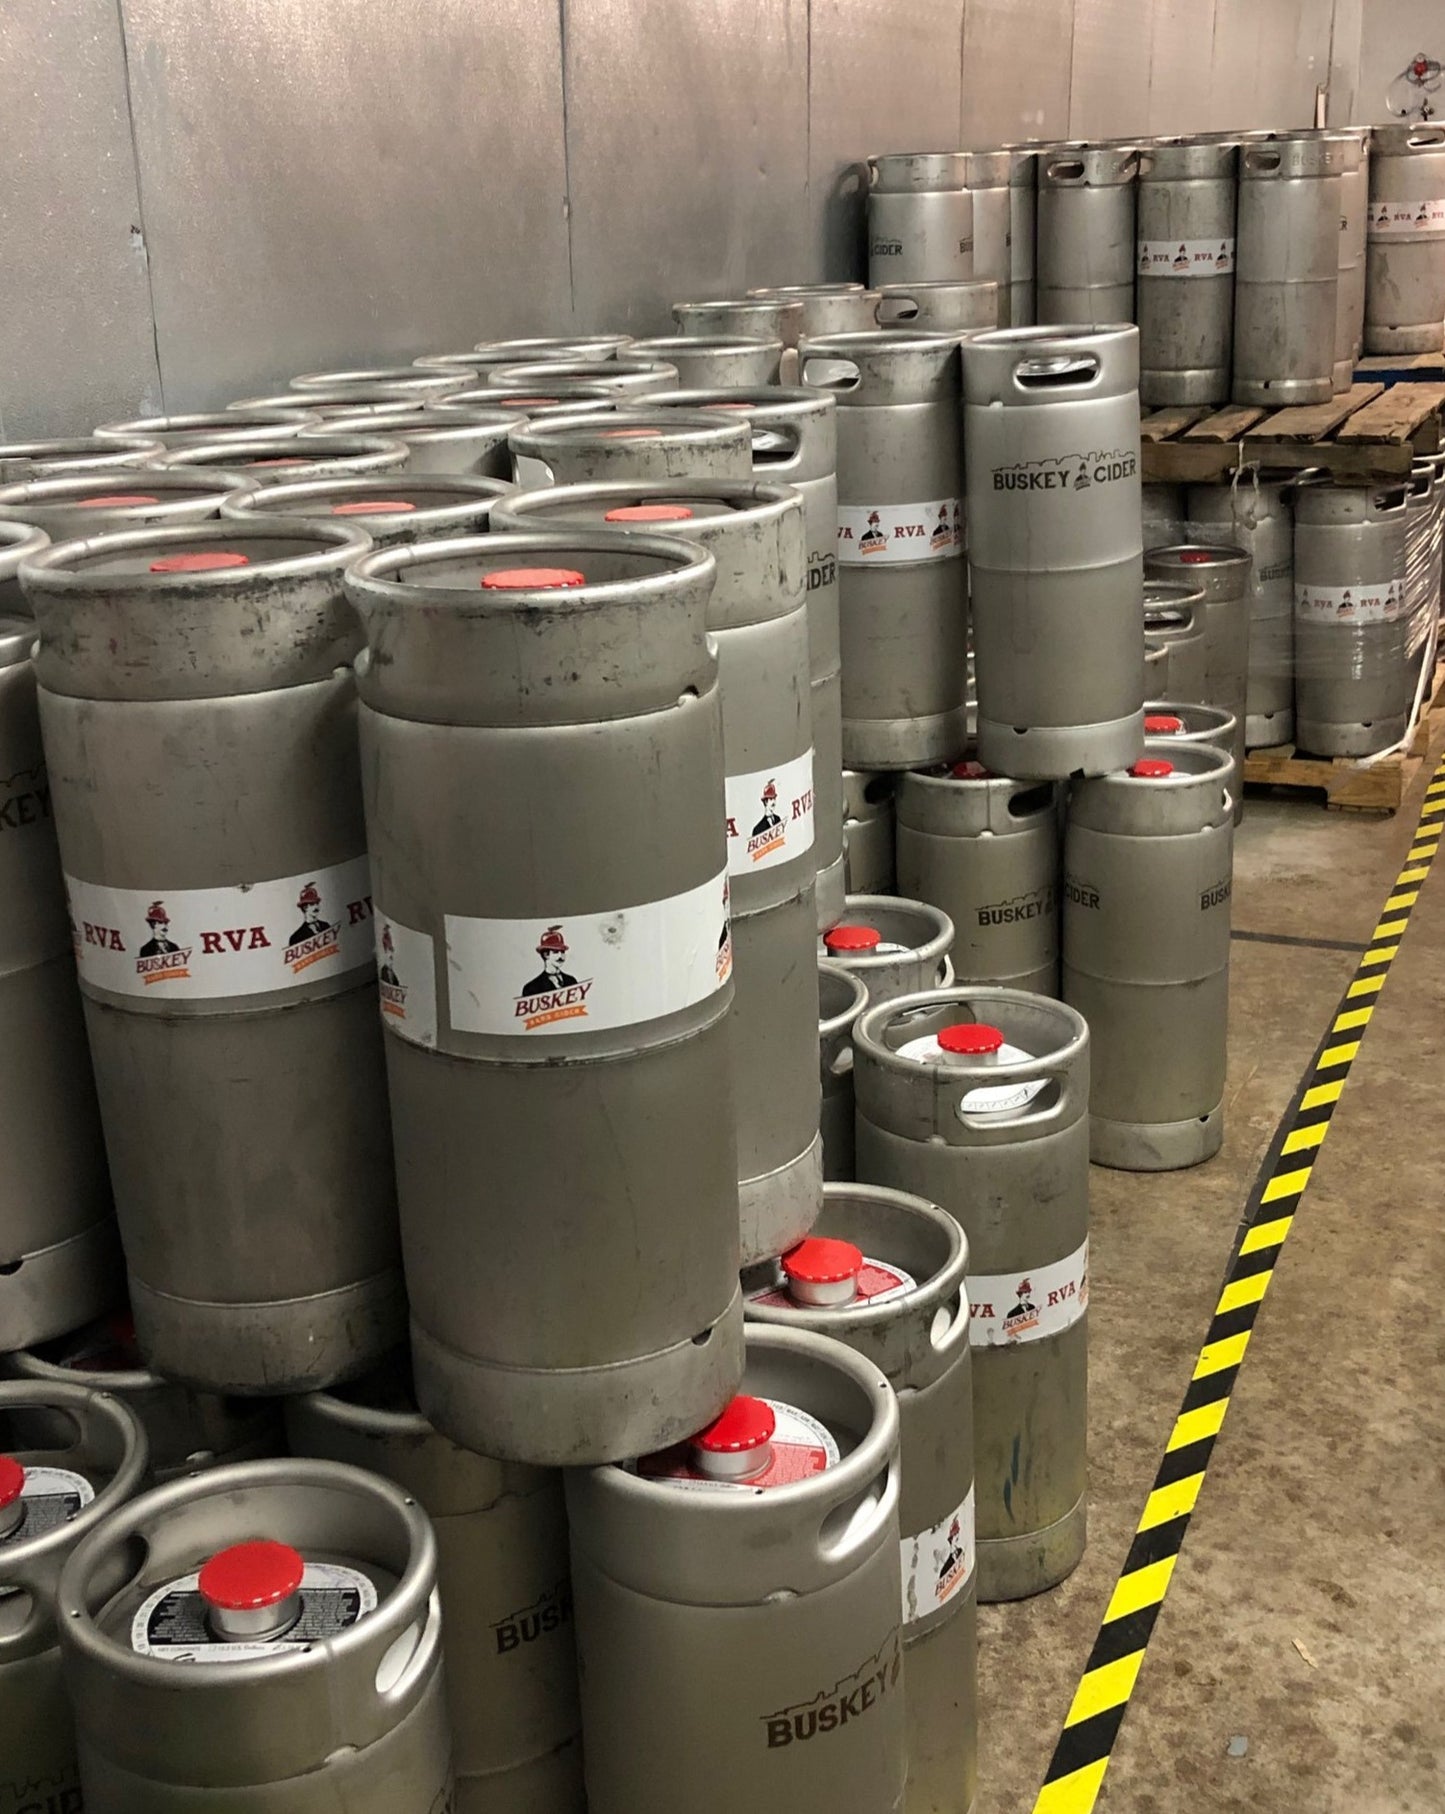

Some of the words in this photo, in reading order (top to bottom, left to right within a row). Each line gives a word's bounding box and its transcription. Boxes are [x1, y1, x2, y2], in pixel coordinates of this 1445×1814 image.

[873, 243, 903, 256] CIDER
[1153, 254, 1170, 263] RVA
[1194, 252, 1213, 262] RVA
[993, 470, 1071, 491] BUSKEY
[1093, 458, 1137, 483] CIDER
[894, 524, 926, 539] RVA
[1360, 597, 1381, 608] RVA
[747, 819, 788, 854] BUSKEY
[977, 900, 1043, 927] BUSKEY
[82, 920, 126, 952] RVA
[199, 926, 272, 955] RVA
[284, 924, 342, 965] BUSKEY
[136, 950, 193, 974] BUSKEY
[514, 982, 593, 1017] BUSKEY
[1047, 1280, 1077, 1307] RVA
[1002, 1305, 1042, 1331] BUSKEY
[767, 1662, 889, 1749] BUSKEY
